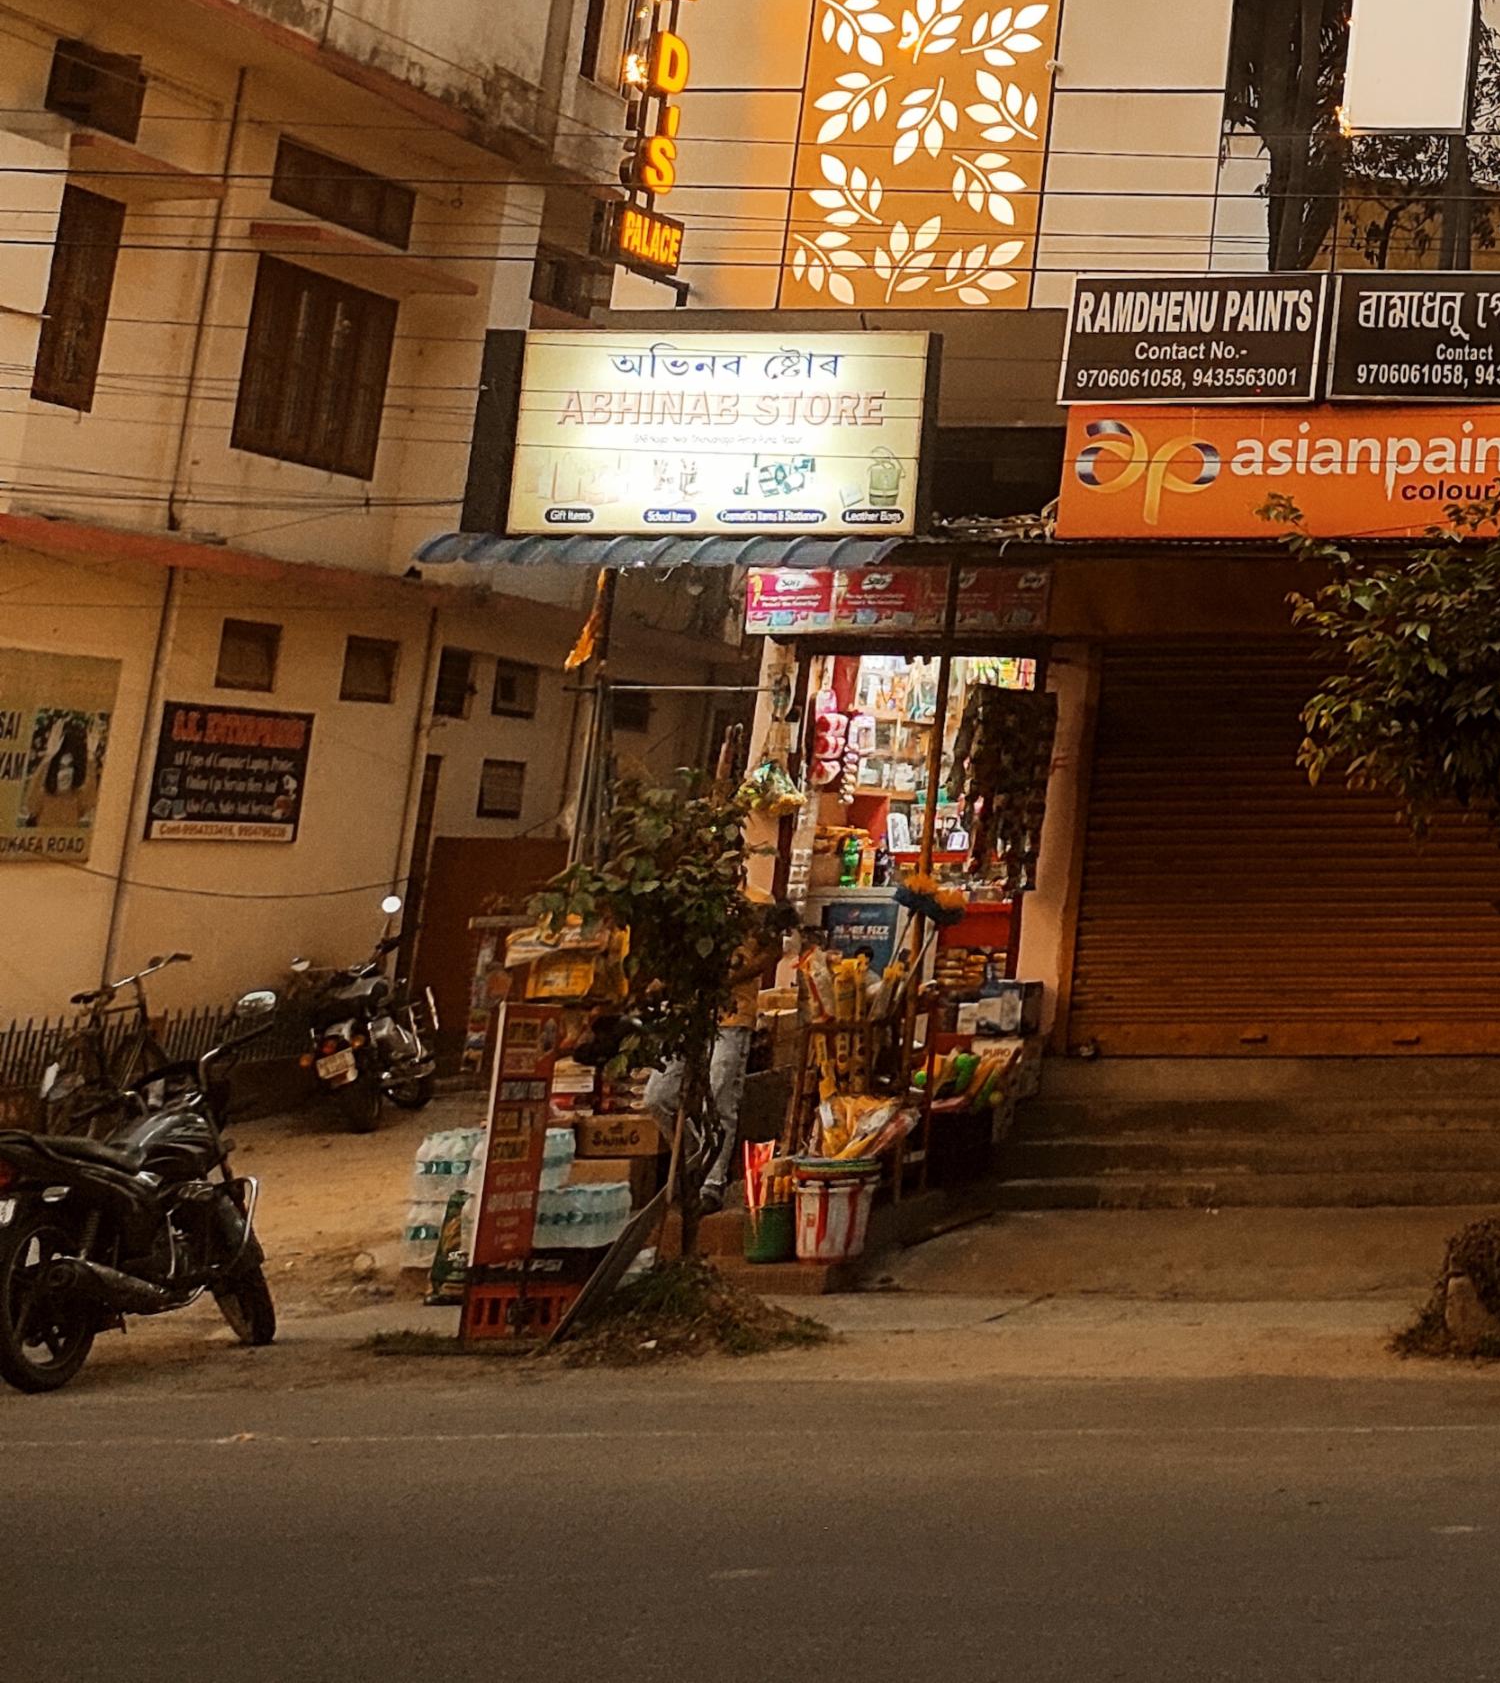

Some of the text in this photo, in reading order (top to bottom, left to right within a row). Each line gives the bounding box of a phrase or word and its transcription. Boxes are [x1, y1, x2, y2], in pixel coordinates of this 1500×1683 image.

[622, 209, 682, 267] PALACE
[1076, 290, 1313, 333] RAMDHENU PAINTS
[607, 342, 747, 378] অভিনব
[1135, 341, 1206, 360] Contact
[1436, 343, 1494, 361] Contact
[1076, 367, 1298, 390] 9706061058, 9435563001
[1356, 364, 1469, 388] 9706061058,
[557, 389, 886, 426] ABHINAB STORE
[550, 509, 567, 522] Gift
[47, 836, 85, 854] ROAD
